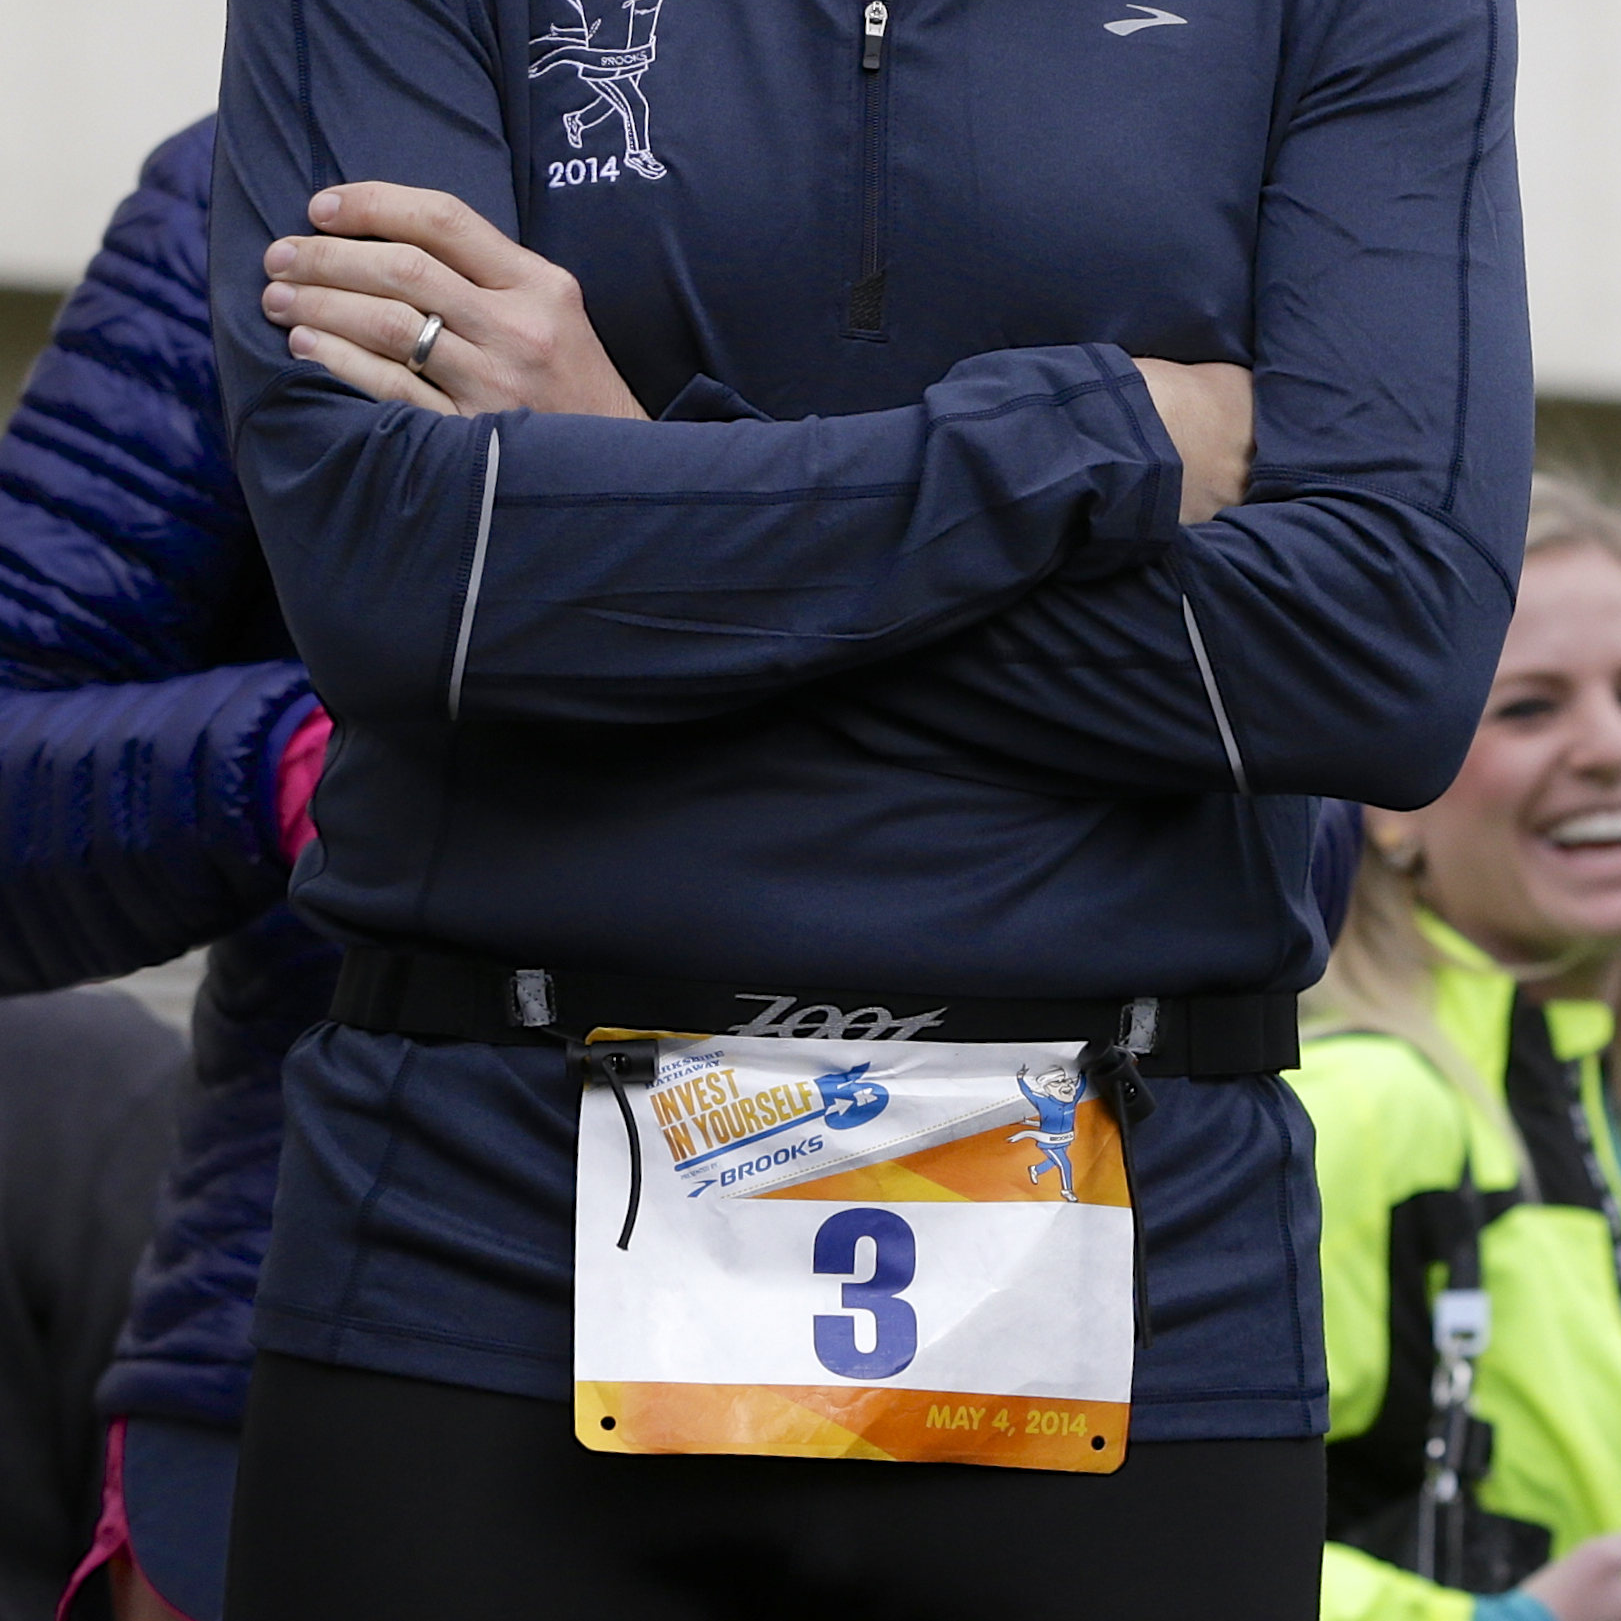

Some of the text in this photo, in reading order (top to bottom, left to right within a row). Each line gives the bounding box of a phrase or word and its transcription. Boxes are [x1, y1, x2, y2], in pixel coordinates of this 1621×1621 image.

[548, 155, 620, 188] 2014
[660, 1050, 725, 1073] RKSHIRE
[650, 1069, 740, 1127] INVEST
[663, 1081, 815, 1162] IN YOURSELF
[720, 1135, 824, 1187] BROOKS
[812, 1207, 918, 1380] 3
[926, 1403, 1088, 1437] MAY 4, 2014
